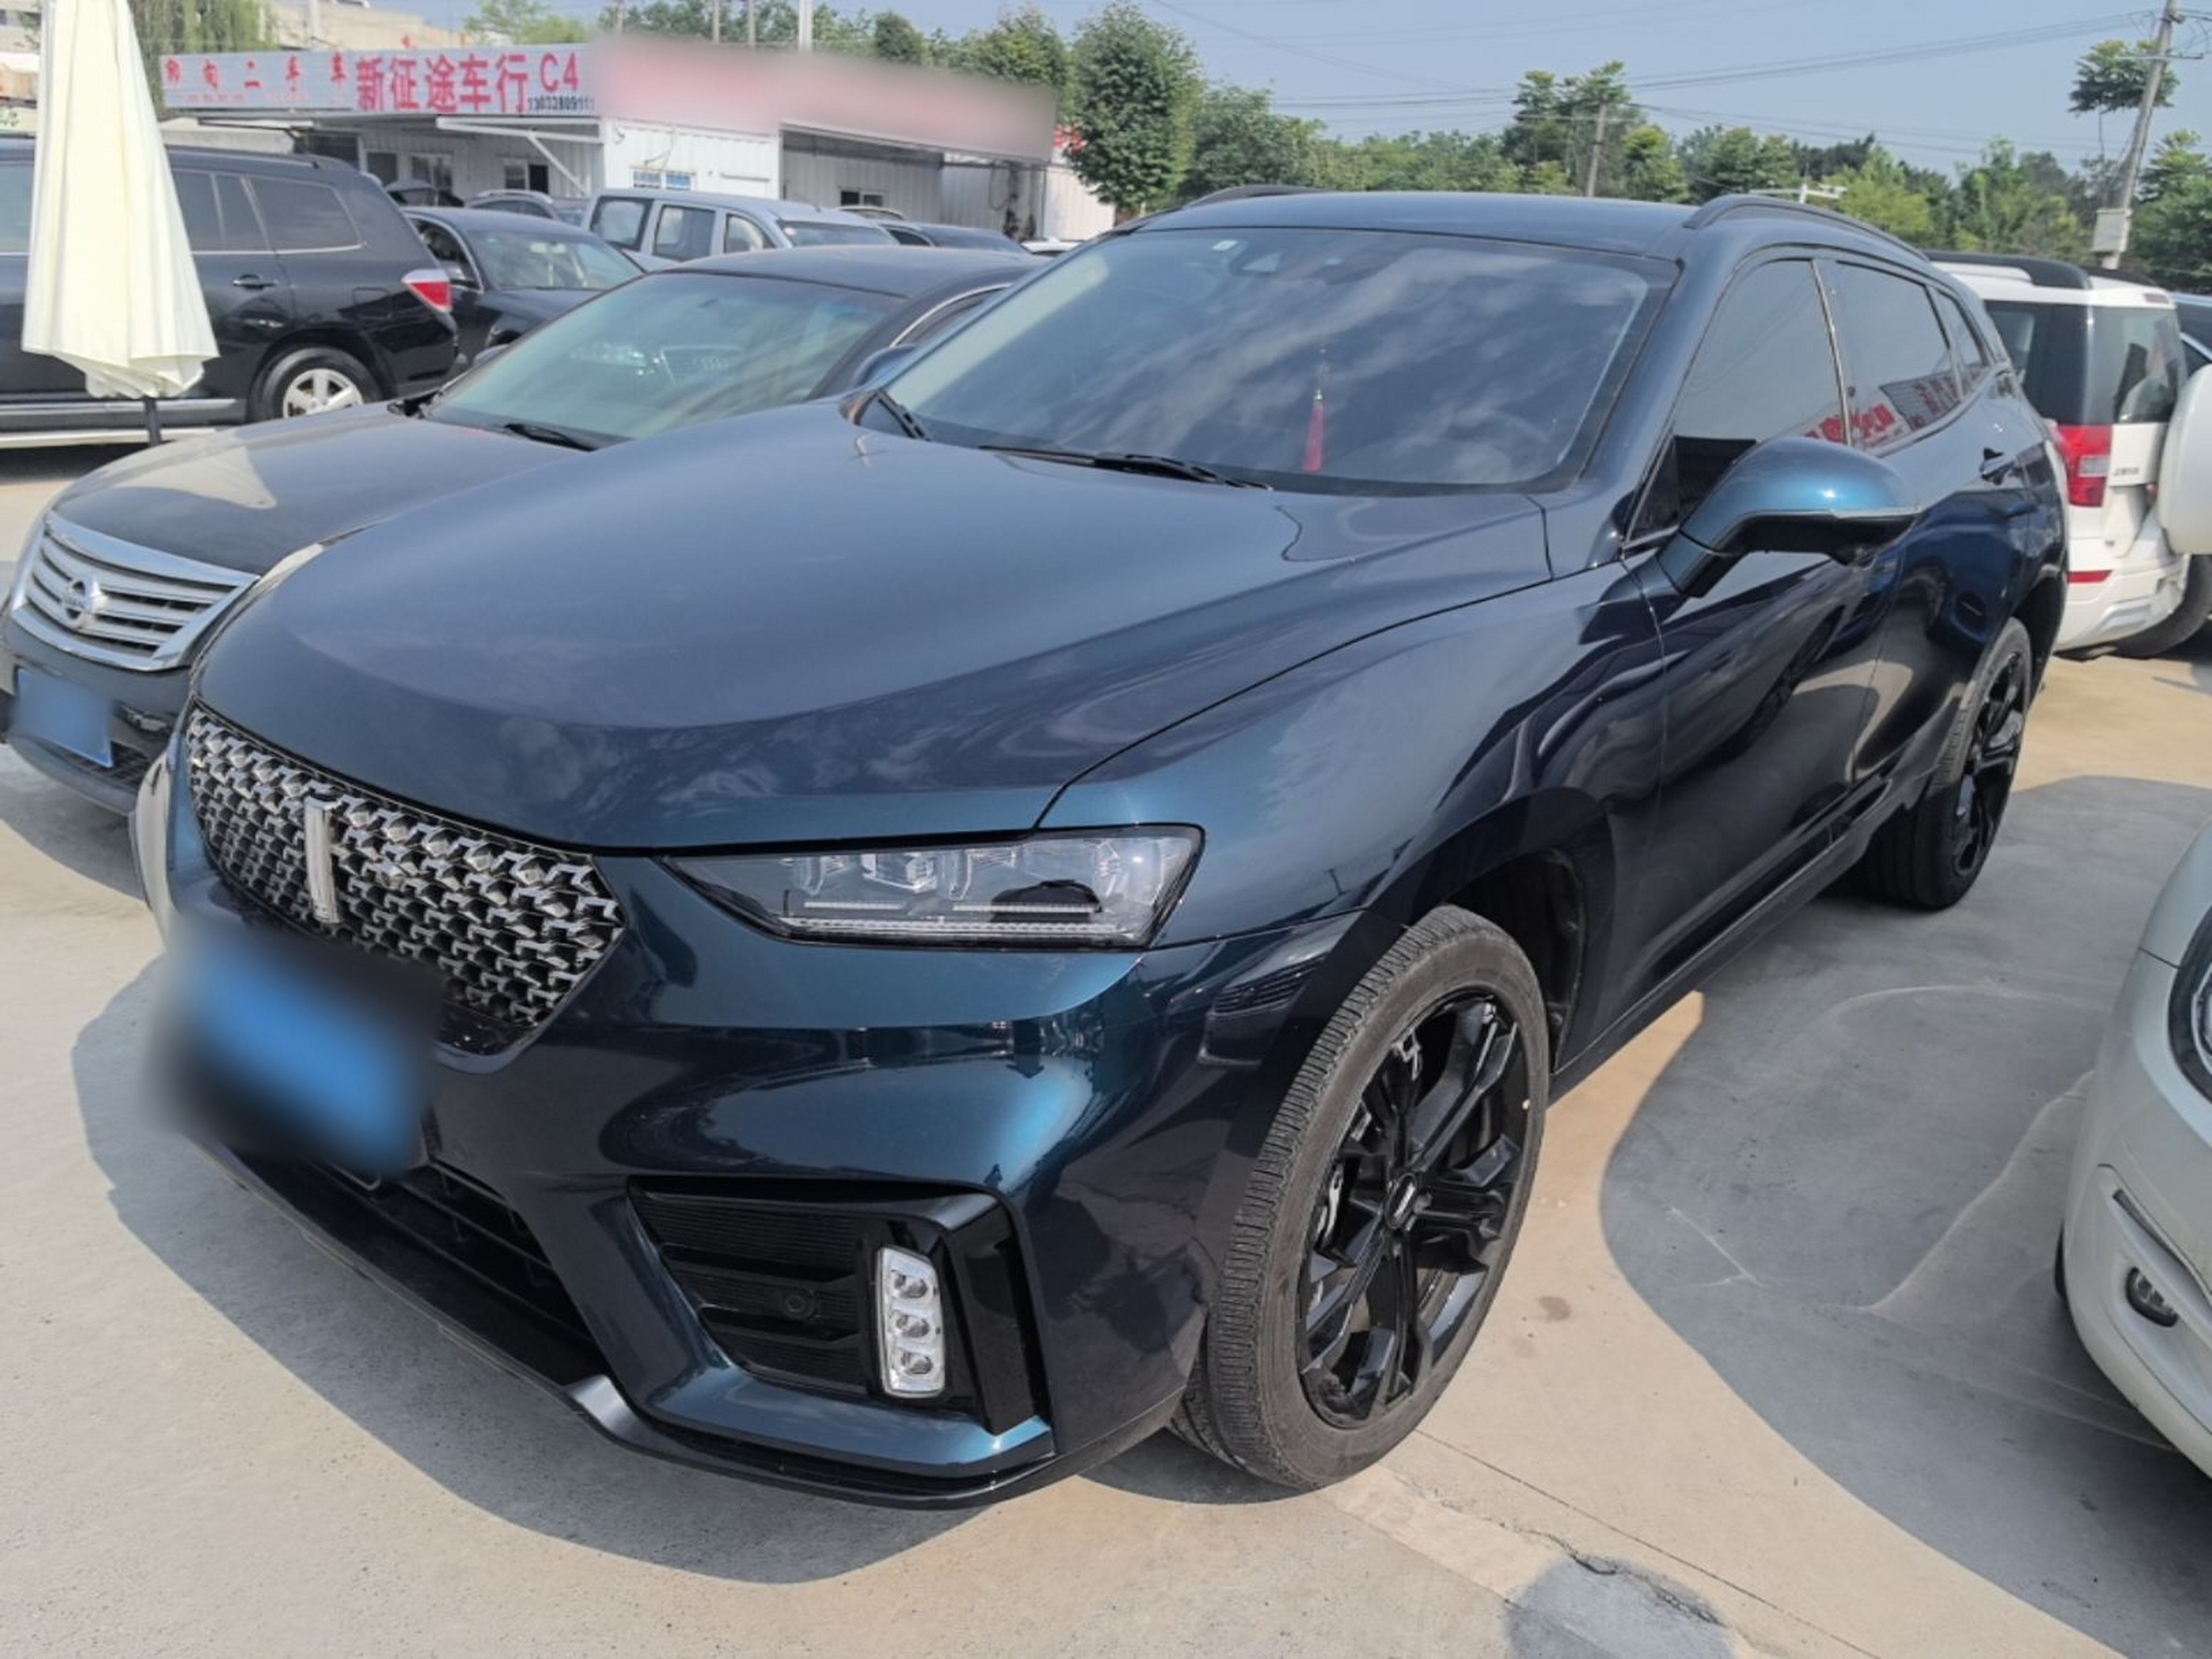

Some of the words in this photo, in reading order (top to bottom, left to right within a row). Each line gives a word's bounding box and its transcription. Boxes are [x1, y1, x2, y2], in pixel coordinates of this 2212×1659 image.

[355, 53, 529, 113] 新征途车行
[540, 52, 579, 93] C4
